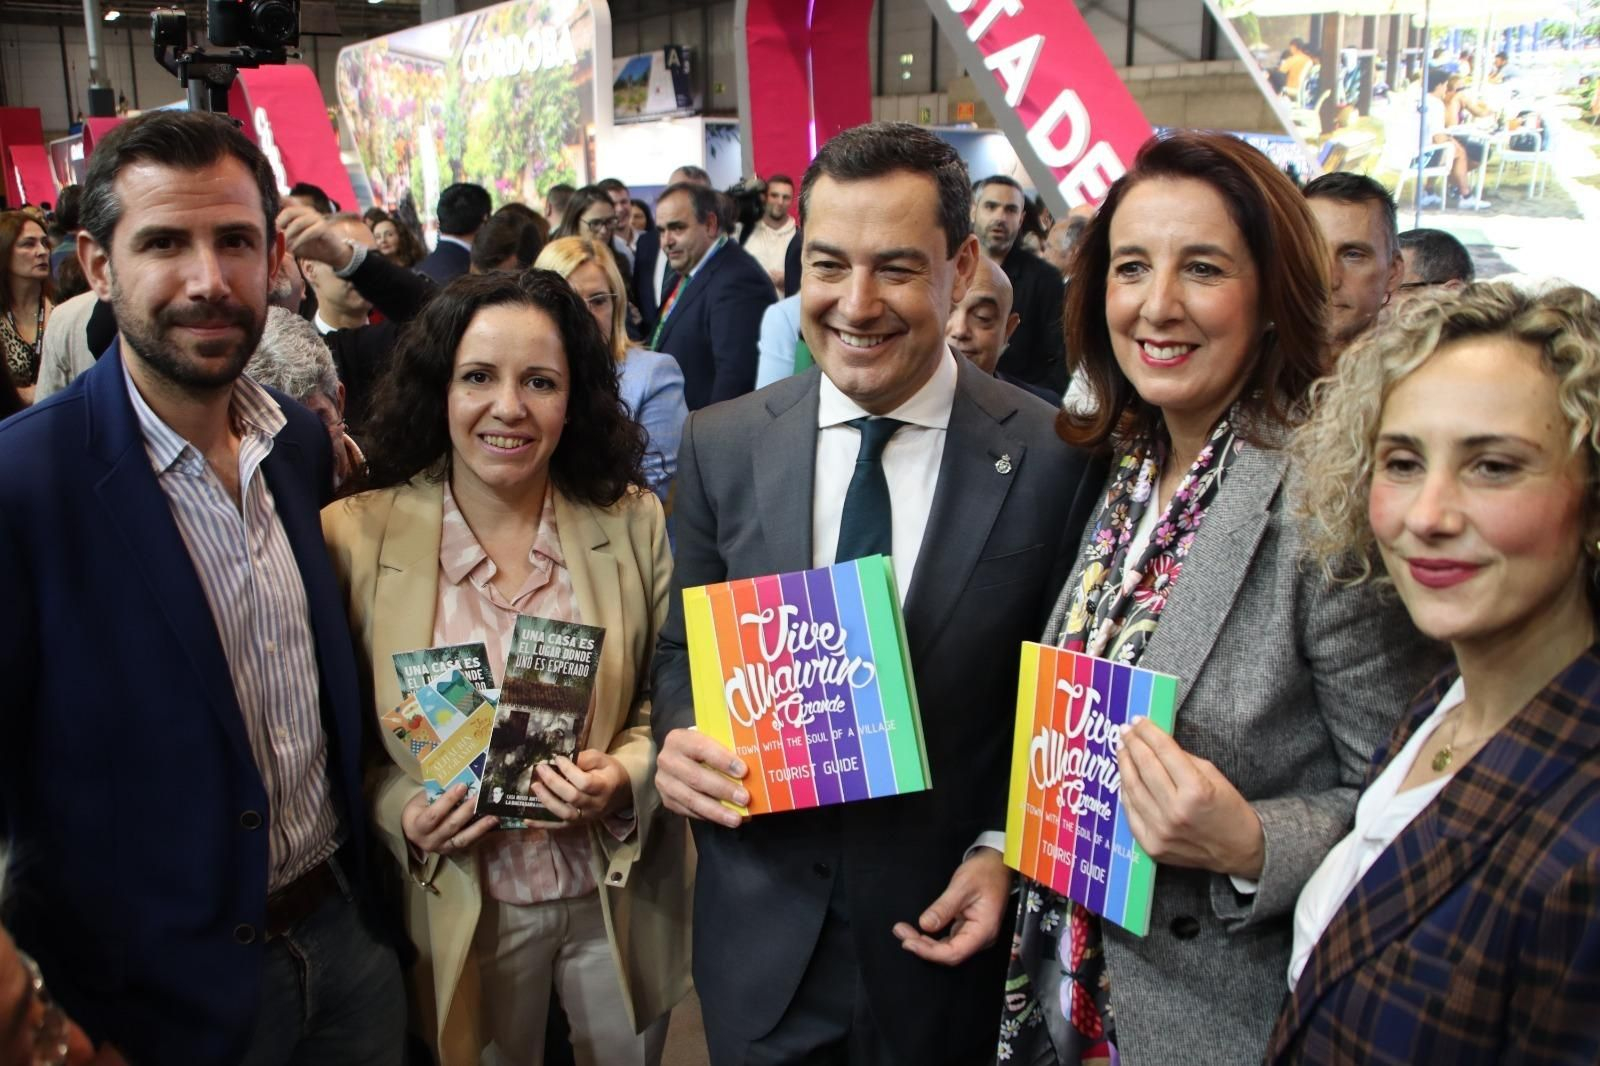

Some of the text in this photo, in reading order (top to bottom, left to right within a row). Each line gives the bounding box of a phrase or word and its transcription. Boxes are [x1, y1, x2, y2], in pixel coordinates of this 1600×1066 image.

[522, 630, 595, 649] UNA CASA ES
[740, 605, 847, 662] Vive
[404, 657, 481, 677] UNA CASA ES
[516, 656, 590, 677] UNO ES ESPERADO
[518, 642, 592, 664] EL LUGAR DONDE
[407, 677, 419, 689] EL
[462, 669, 485, 681] NDE
[772, 693, 846, 731] el Grande
[1057, 679, 1121, 755] Vive
[737, 719, 897, 756] TOWN WITH THE SOUL OF A VILLAGE
[768, 757, 859, 784] TOURIST GUIDE
[1062, 780, 1111, 820] Grande
[1026, 803, 1042, 817] TOWN
[1045, 812, 1060, 825] WITH
[1062, 819, 1075, 833] THE
[1076, 824, 1092, 842] SOUL
[1094, 833, 1103, 846] OF
[1104, 839, 1111, 849] A
[1112, 843, 1140, 864] VILLAGE
[1041, 839, 1107, 882] TOURIST GUIDE
